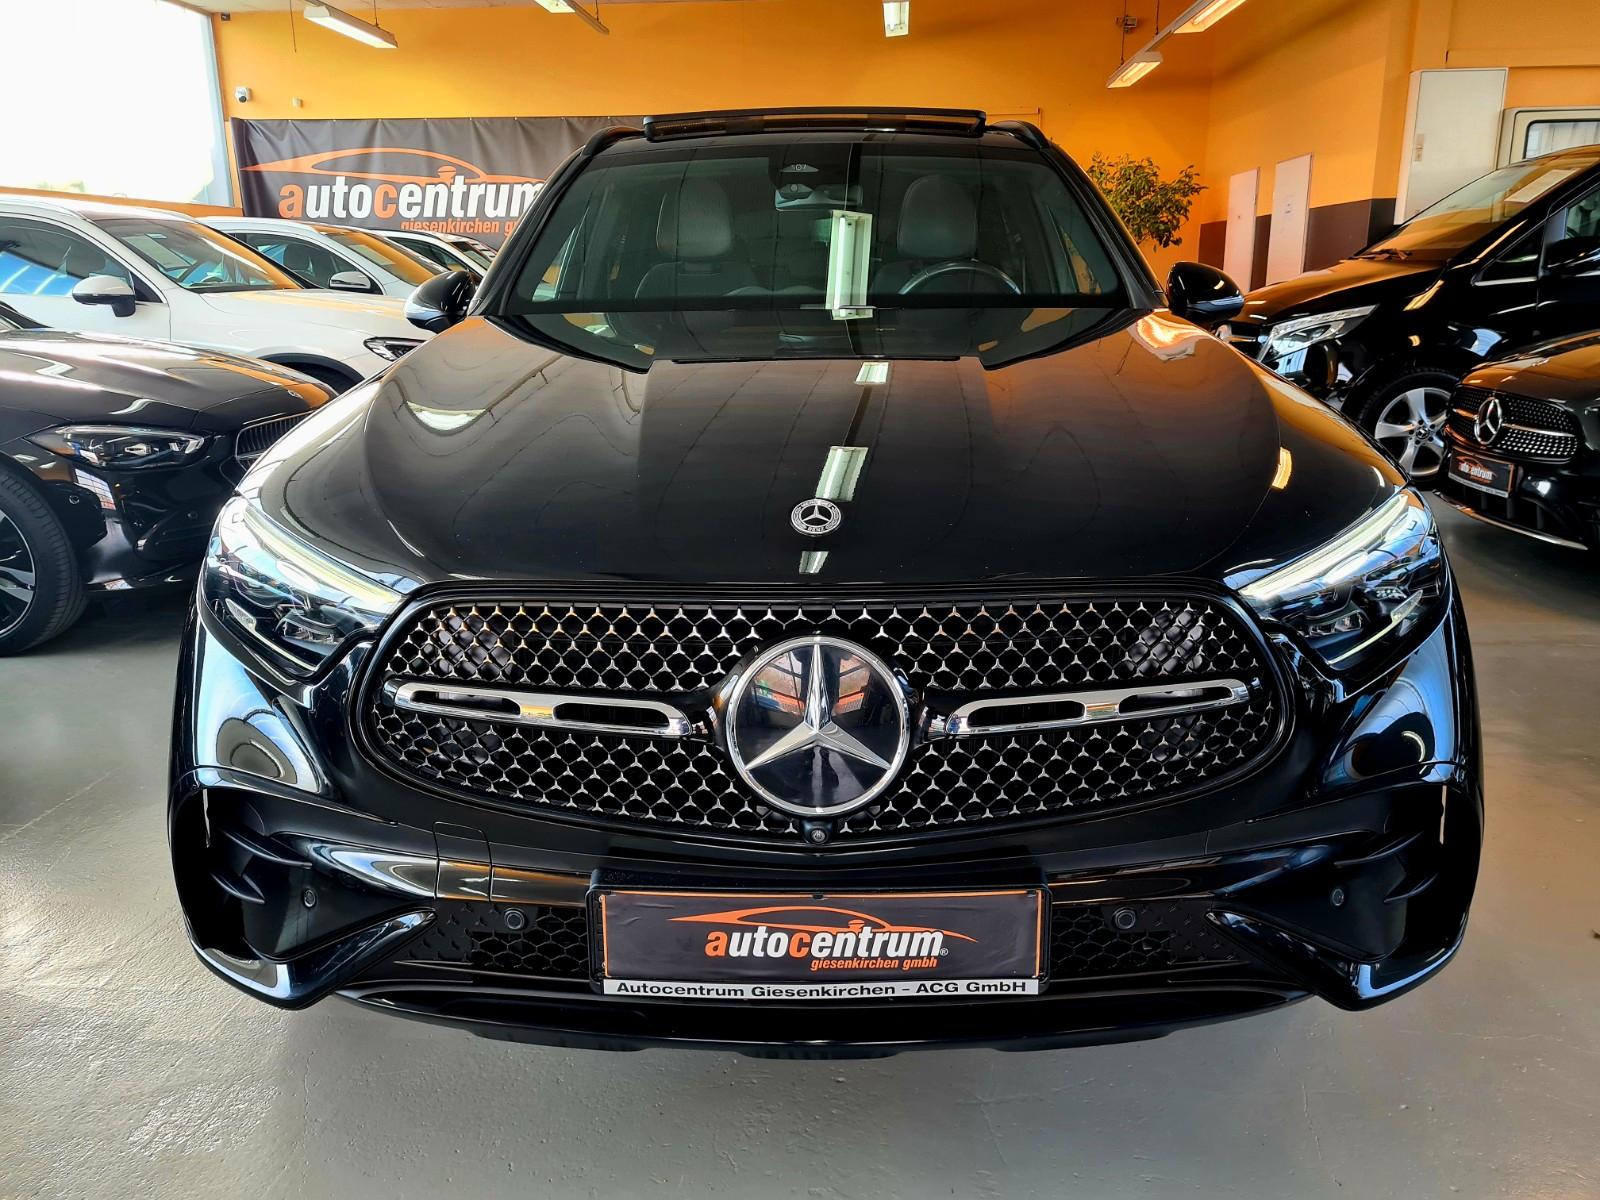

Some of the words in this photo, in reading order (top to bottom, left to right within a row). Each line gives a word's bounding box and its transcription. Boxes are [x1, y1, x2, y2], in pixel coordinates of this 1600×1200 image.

[704, 926, 944, 958] autocentrum
[810, 957, 899, 971] giesenkirchen
[902, 956, 938, 970] gmbh
[616, 982, 745, 997] Autocentrum
[751, 984, 896, 998] Giesenkirchen
[915, 982, 959, 994] ACG
[966, 981, 1026, 993] GmbH
